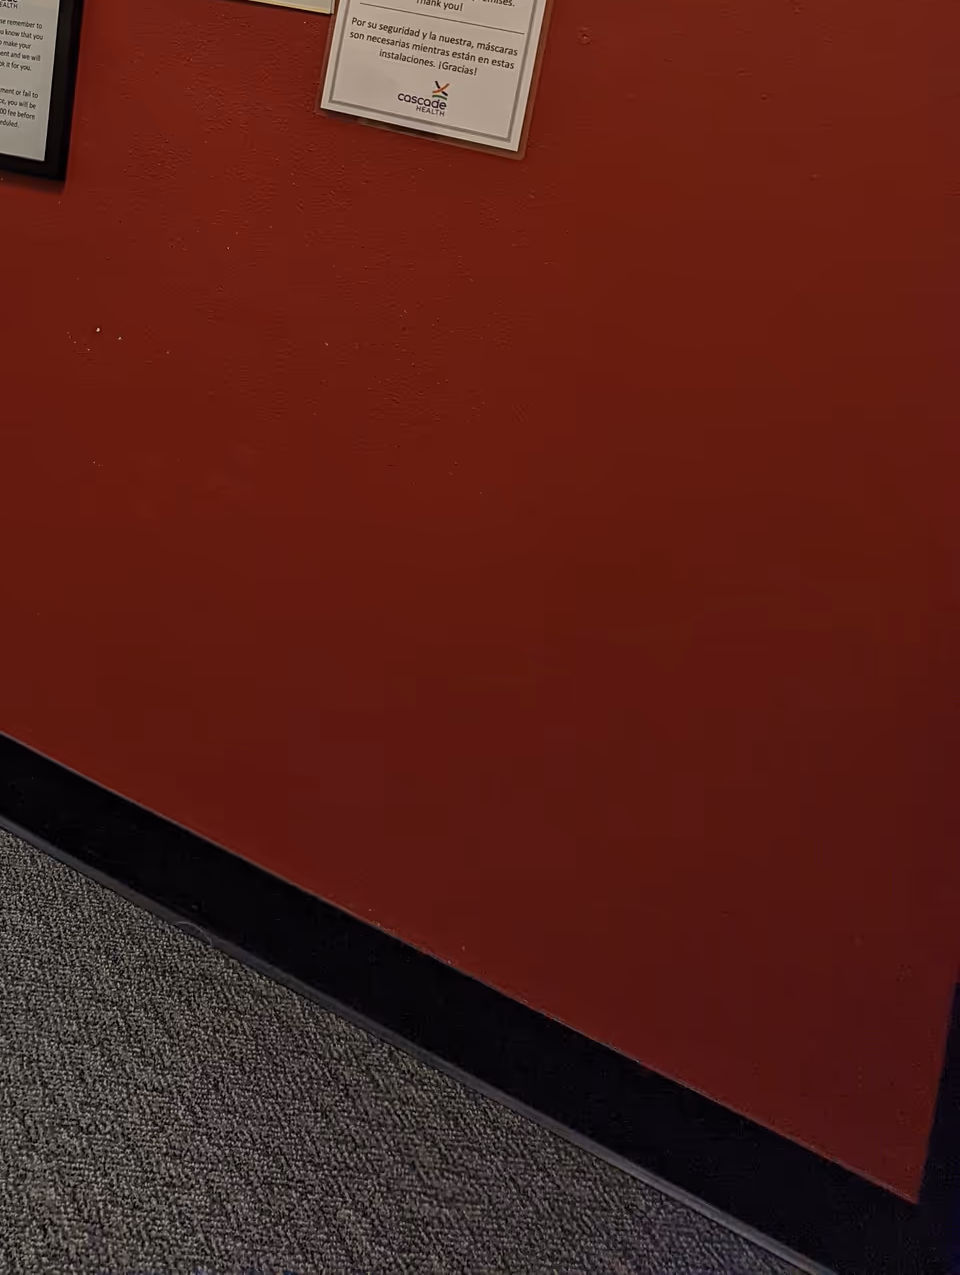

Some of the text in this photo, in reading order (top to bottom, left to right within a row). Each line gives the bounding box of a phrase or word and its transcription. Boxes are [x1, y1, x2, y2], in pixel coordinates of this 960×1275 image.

[442, 1, 463, 12] you!
[7, 19, 35, 28] remember
[5, 29, 19, 37] know
[21, 31, 32, 39] that
[352, 17, 518, 56] Por su seguridad y la nuestra, máscaras
[350, 31, 515, 69] son necesarias mientras están en estas
[379, 49, 478, 76] instalaciones. ¡Gracias!
[398, 92, 446, 109] cascade
[17, 111, 35, 120] before
[416, 106, 445, 117] HEALTH
